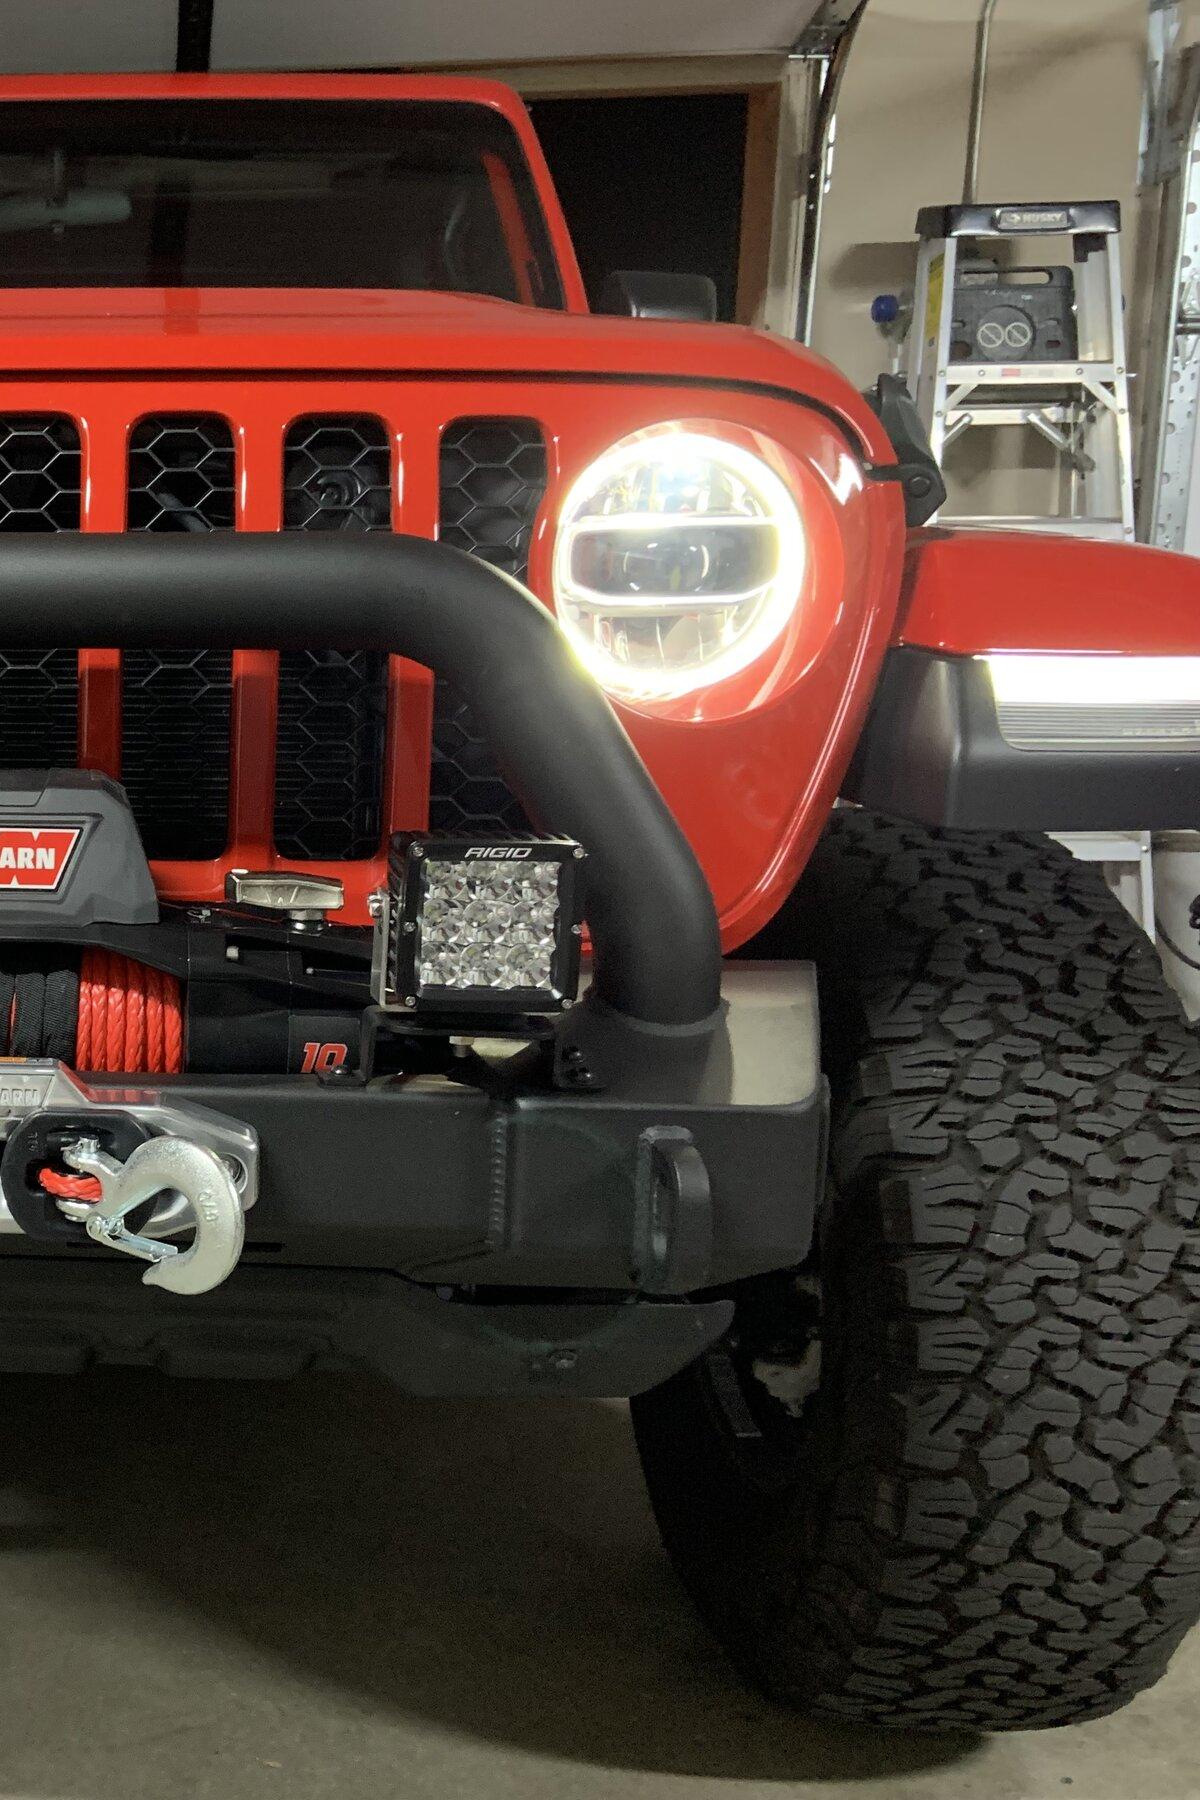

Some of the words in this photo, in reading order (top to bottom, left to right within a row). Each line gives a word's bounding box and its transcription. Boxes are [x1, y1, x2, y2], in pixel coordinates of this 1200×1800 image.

[1022, 211, 1063, 224] HUSKY
[464, 847, 533, 859] RIGID
[301, 1042, 348, 1074] 10
